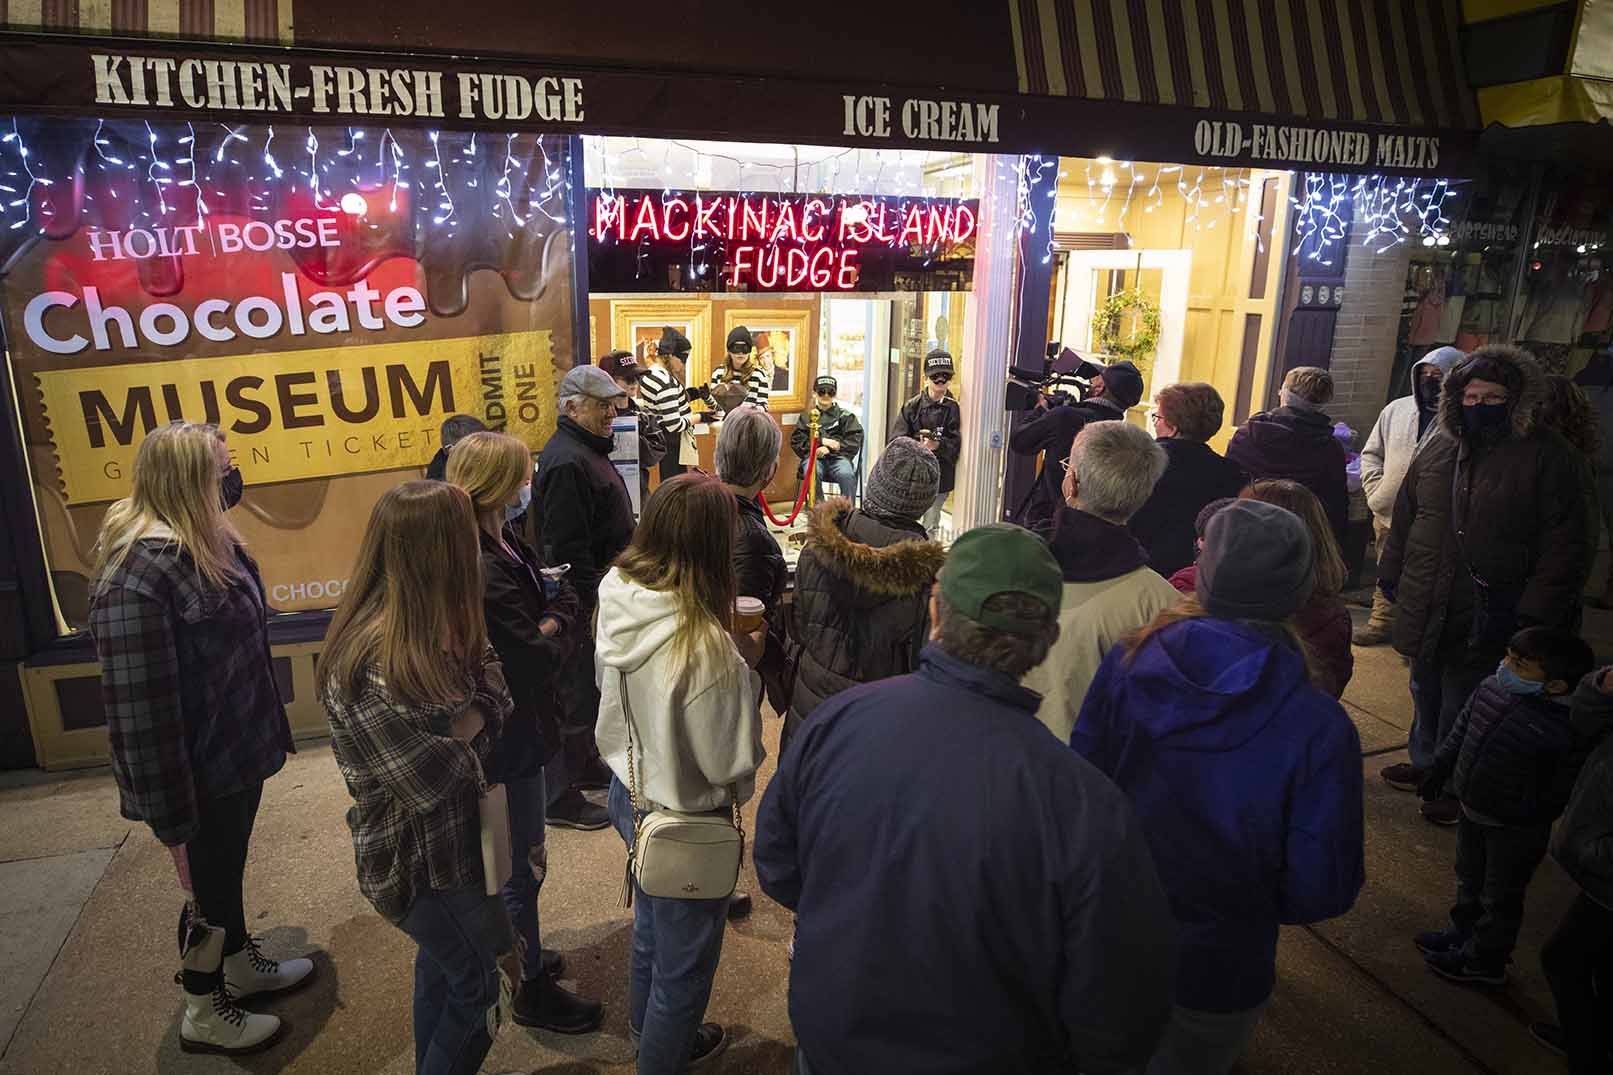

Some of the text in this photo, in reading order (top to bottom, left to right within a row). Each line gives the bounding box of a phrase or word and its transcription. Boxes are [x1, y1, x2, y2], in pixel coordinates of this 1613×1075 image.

[91, 53, 585, 122] KITCHEN-FRESH FUDGE
[843, 95, 1000, 143] ICE CREAM
[1194, 120, 1440, 169] OLD-FASHIONED MALTS
[89, 217, 341, 262] HOLT BOSSE
[592, 194, 975, 245] MACKINAC ISLAND
[730, 245, 859, 289] FUDGE
[24, 271, 427, 355] Chocolate
[78, 360, 457, 449] MUSEUM
[514, 363, 540, 424] ONE
[103, 428, 434, 481] GEN TICKET
[272, 579, 351, 602] CHOC
